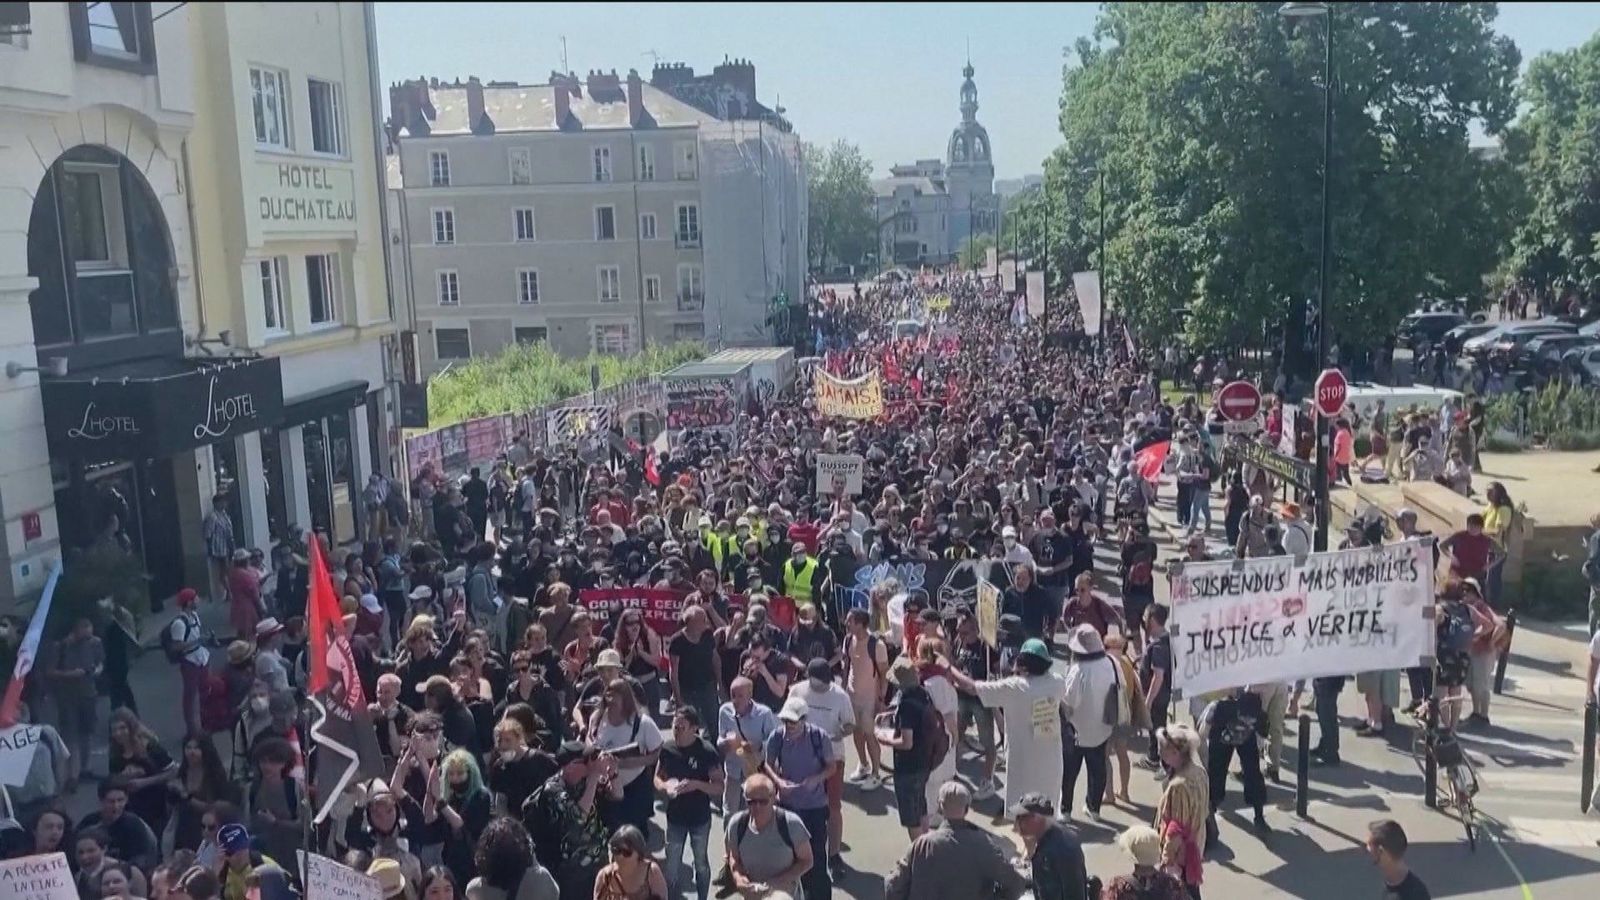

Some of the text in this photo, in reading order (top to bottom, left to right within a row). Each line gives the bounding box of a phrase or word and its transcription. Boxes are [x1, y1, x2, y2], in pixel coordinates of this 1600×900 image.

[278, 164, 333, 190] HOTEL
[1320, 386, 1344, 401] STOP
[1191, 571, 1286, 597] SUSPENDUS
[588, 598, 648, 610] CONTRE
[1308, 600, 1387, 637] VÉRITÉ
